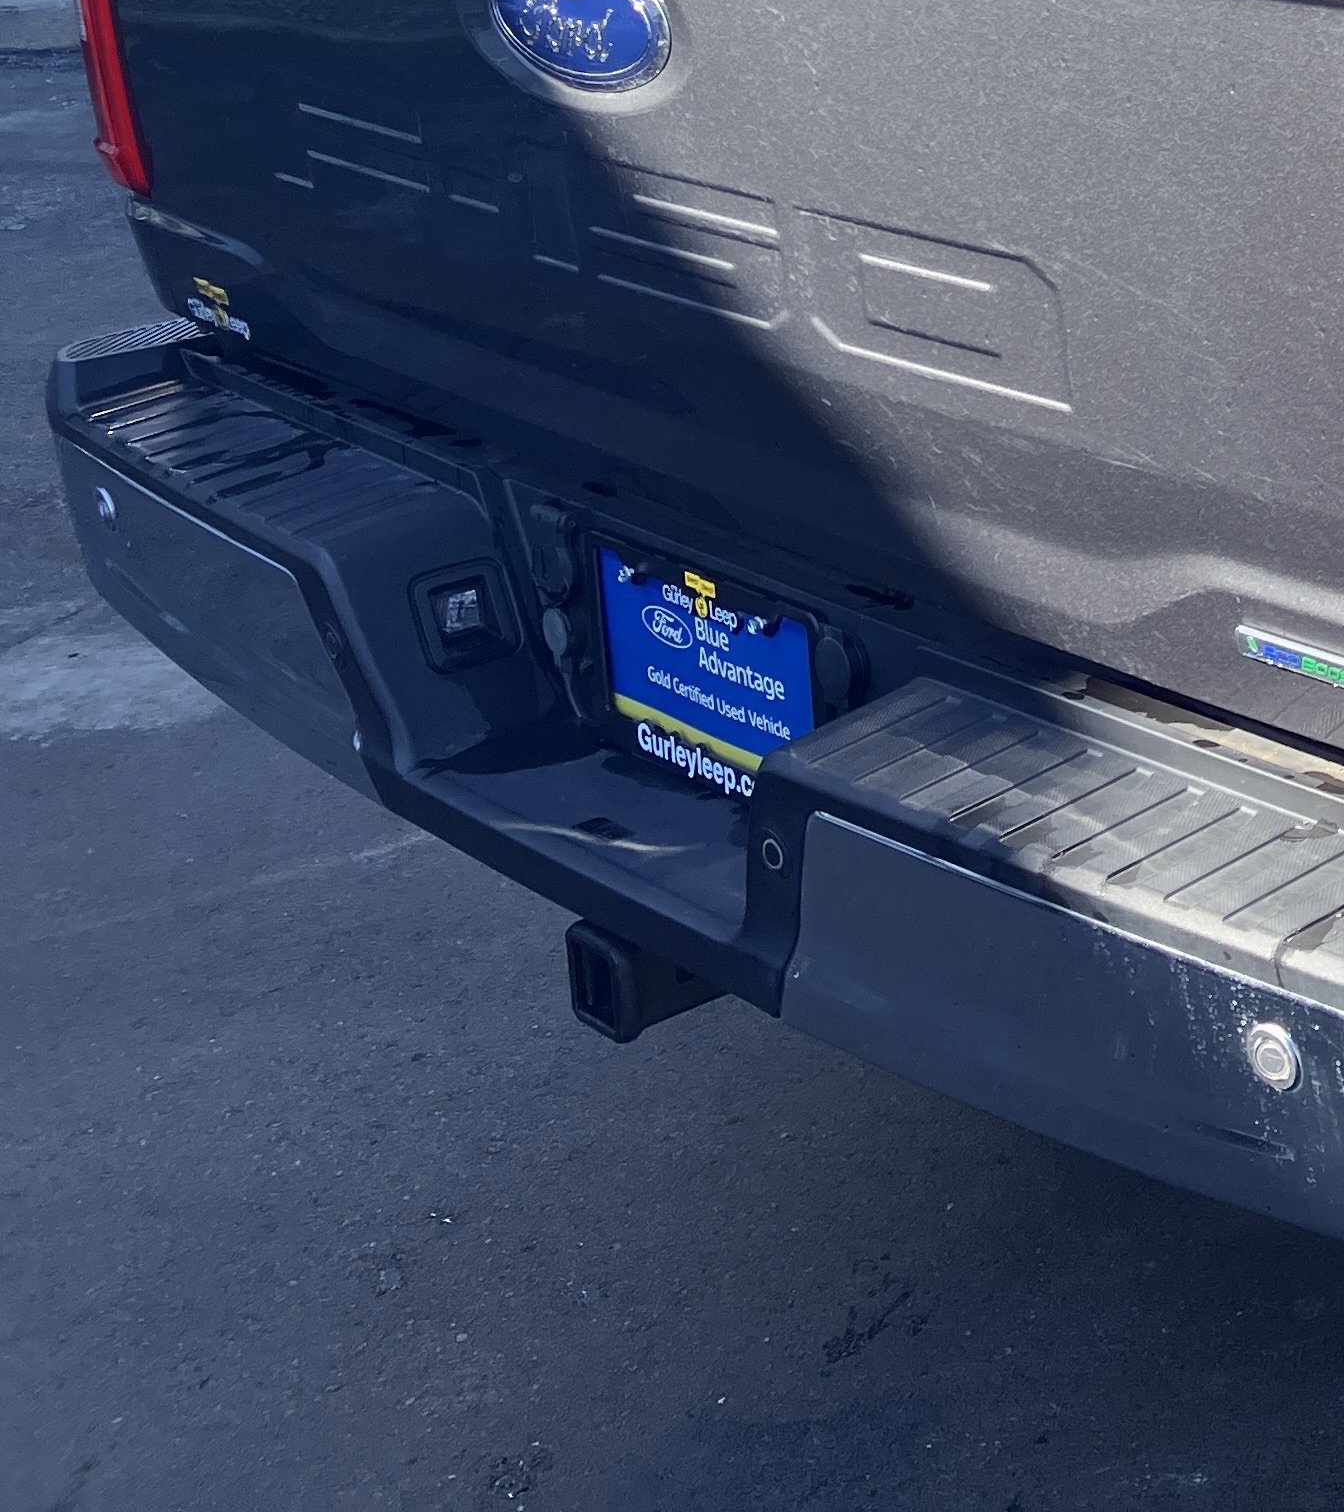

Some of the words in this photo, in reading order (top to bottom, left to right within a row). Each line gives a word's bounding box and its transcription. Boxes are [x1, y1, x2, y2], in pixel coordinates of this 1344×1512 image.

[652, 609, 684, 644] Ford
[694, 616, 730, 652] Blue
[708, 600, 737, 632] Leep
[699, 646, 785, 701] Advantage
[647, 665, 671, 689] Gold
[672, 677, 715, 711] Certified
[716, 697, 746, 723] Used
[748, 709, 791, 741] Vehicle
